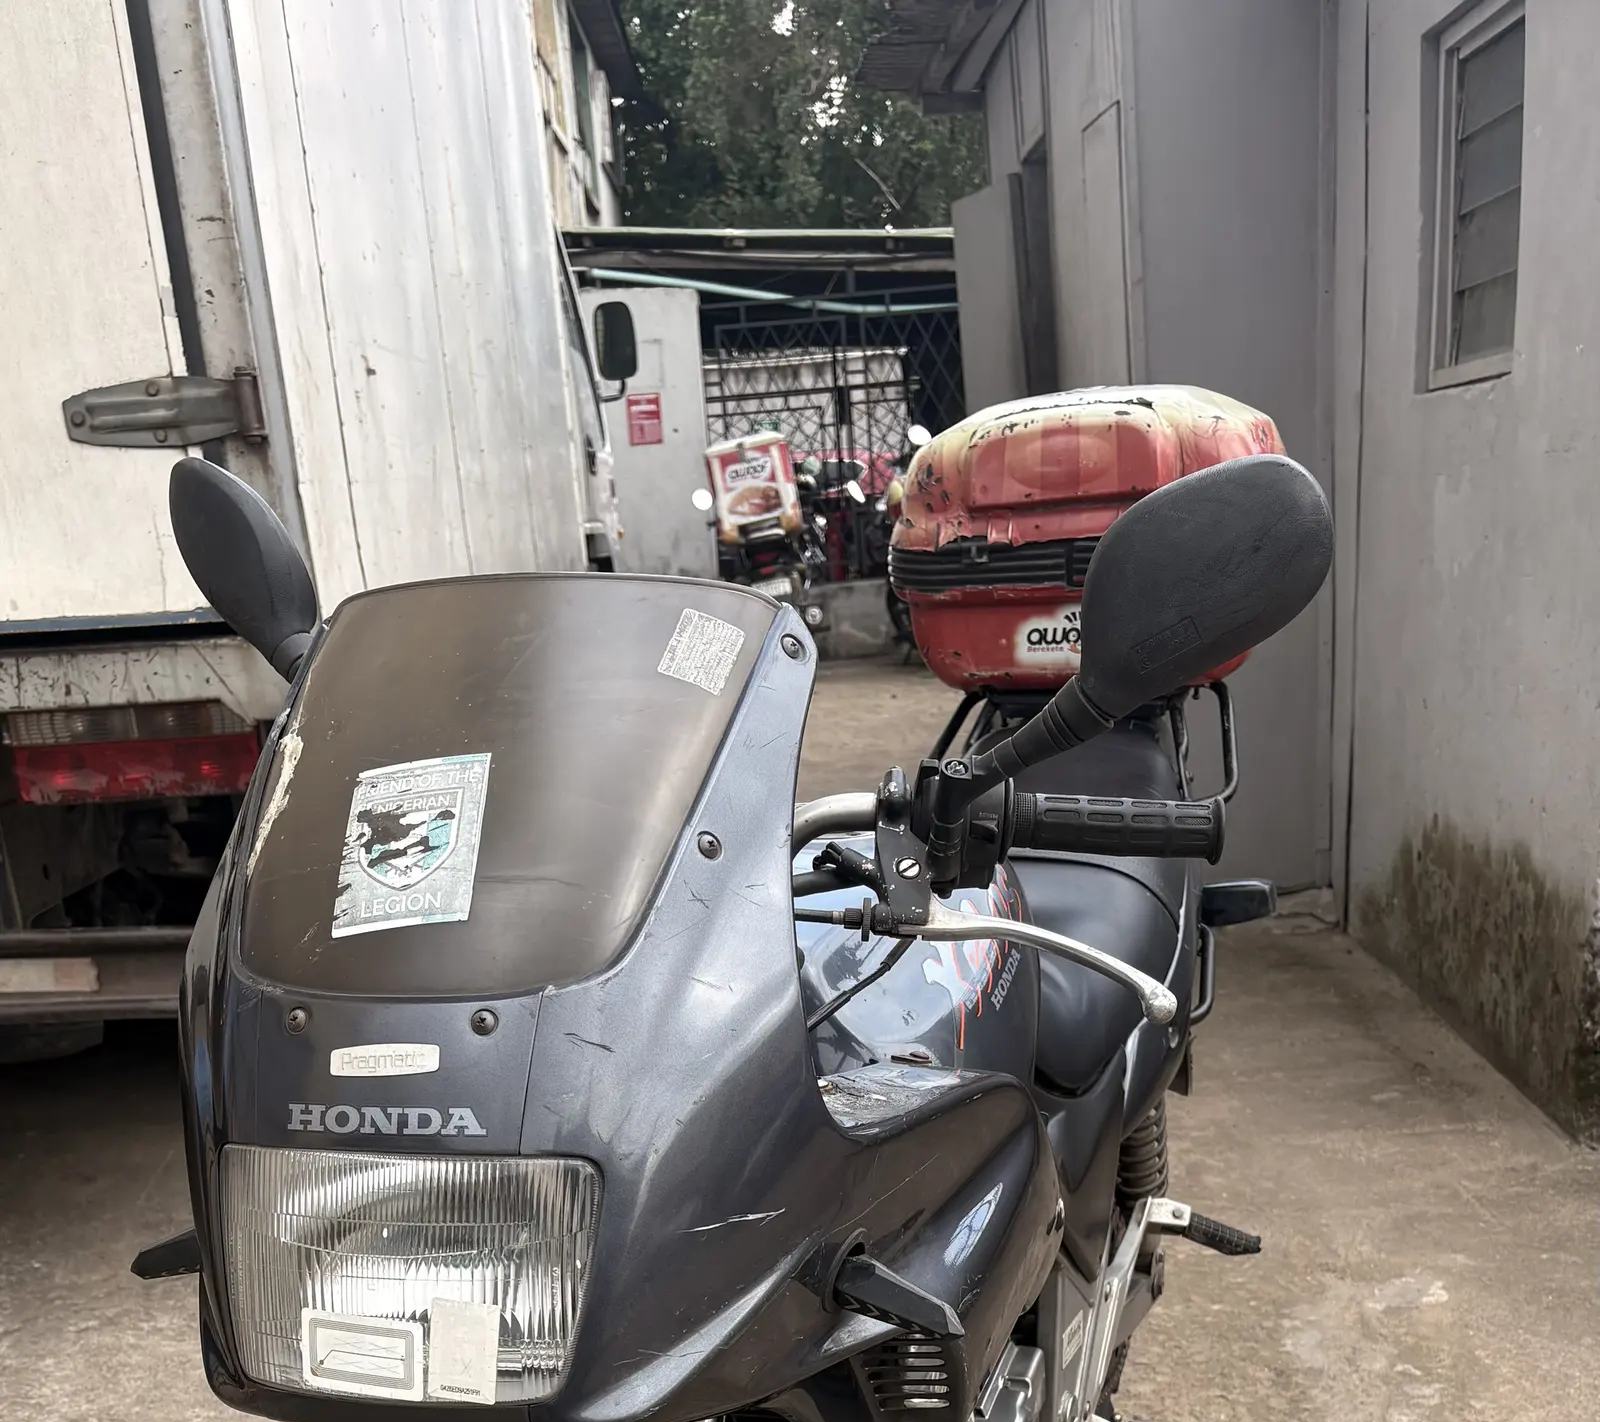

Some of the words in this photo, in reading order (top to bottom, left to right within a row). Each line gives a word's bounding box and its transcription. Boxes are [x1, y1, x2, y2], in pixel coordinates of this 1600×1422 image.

[1027, 627, 1081, 646] awo
[357, 776, 414, 799] FRIEND
[418, 771, 443, 790] OF
[447, 767, 481, 785] THE
[360, 892, 442, 918] LEGION
[990, 948, 1021, 1011] HONDA
[341, 1050, 426, 1073] Pragmatic
[287, 1103, 489, 1137] HONDA
